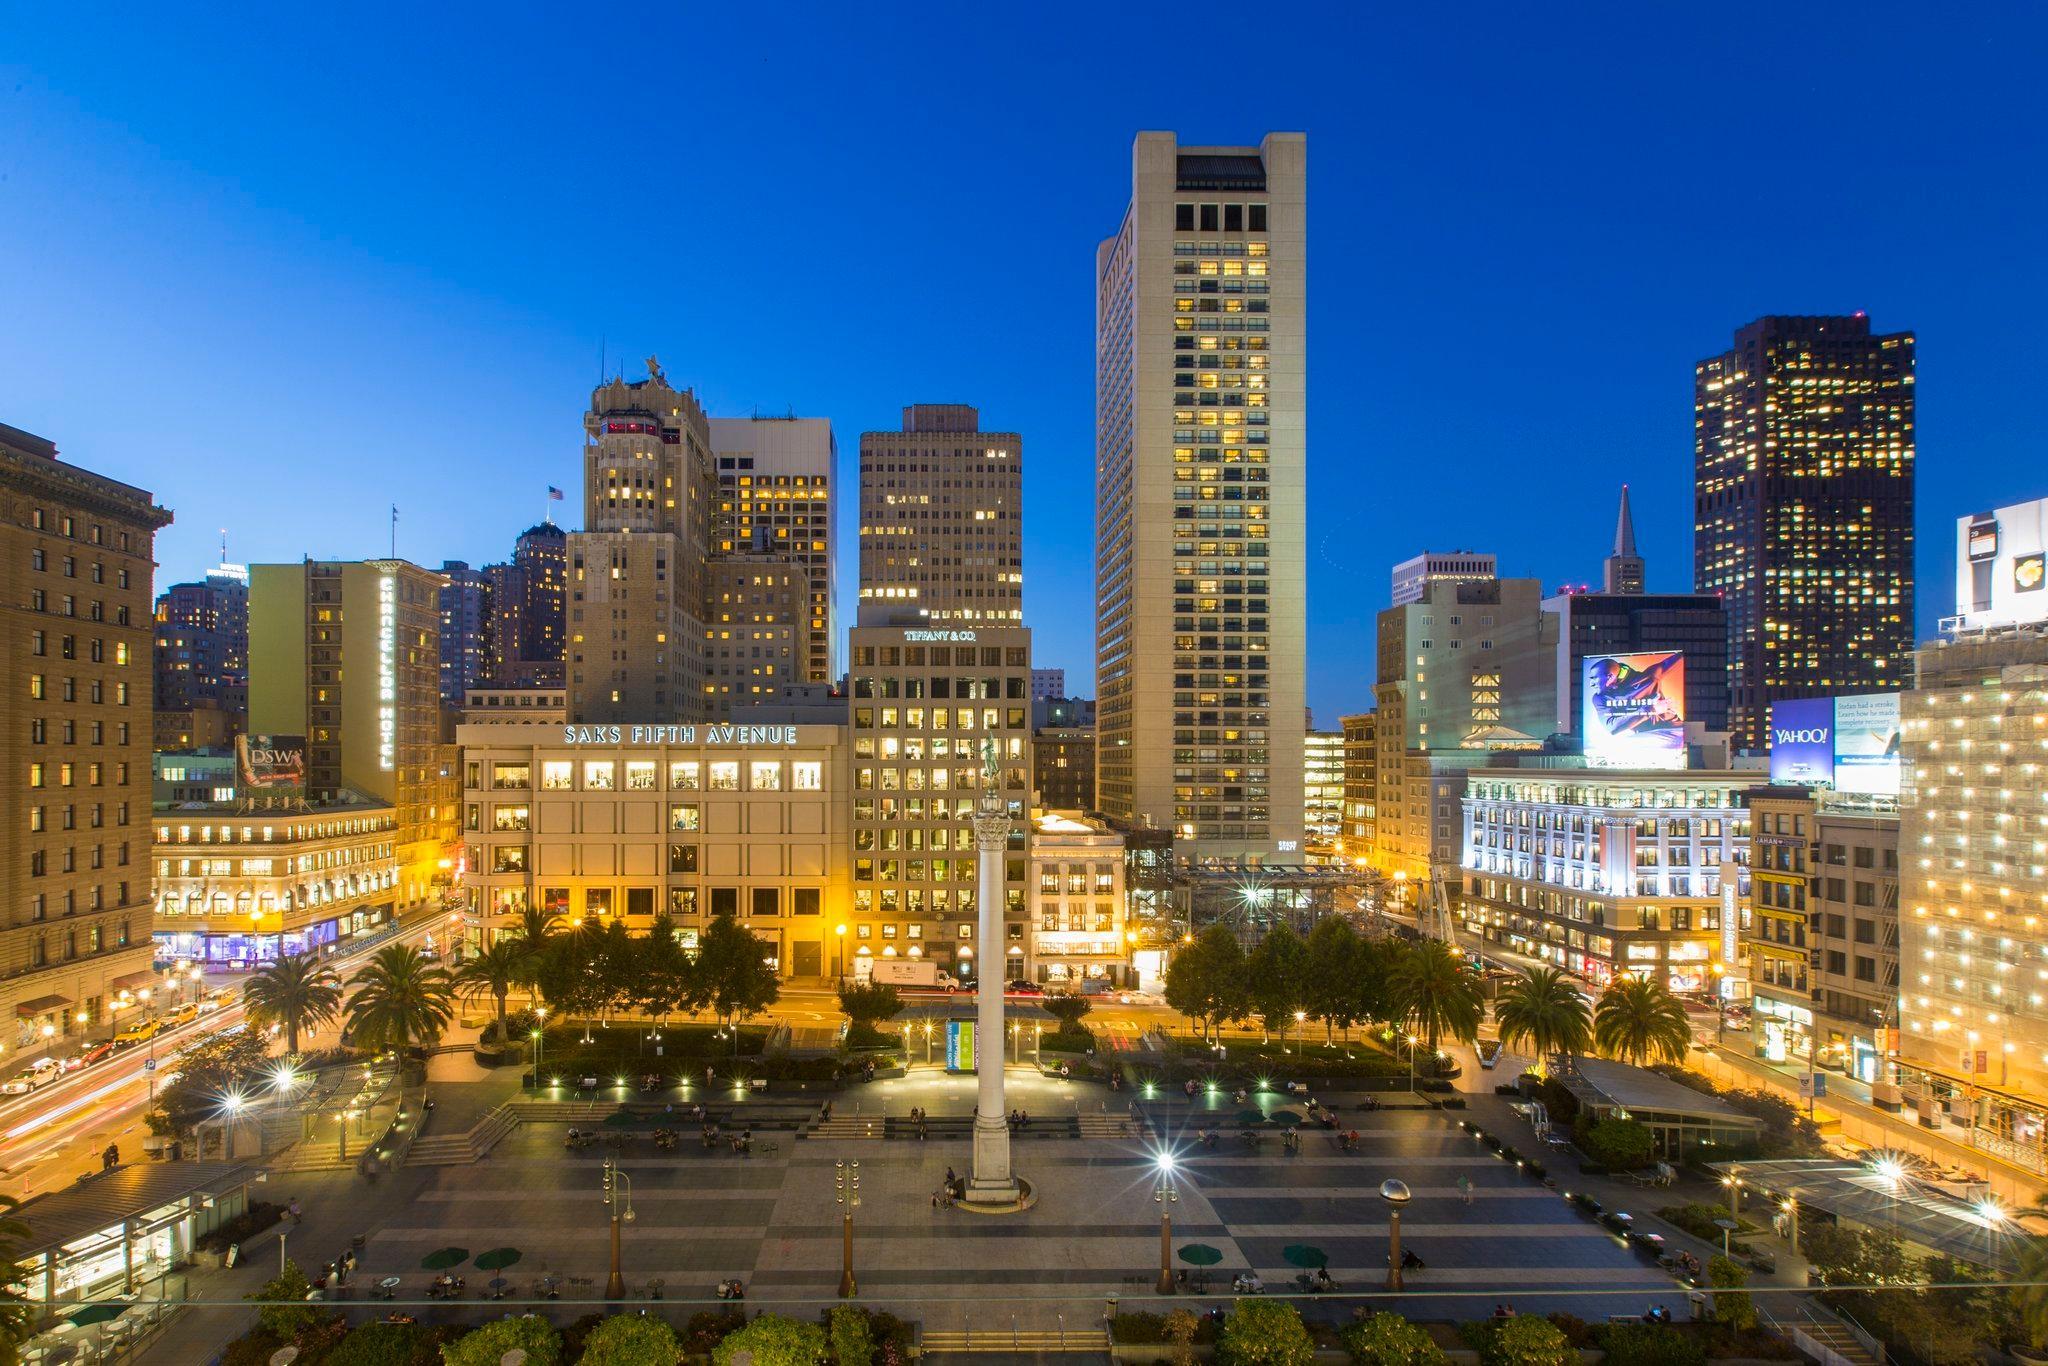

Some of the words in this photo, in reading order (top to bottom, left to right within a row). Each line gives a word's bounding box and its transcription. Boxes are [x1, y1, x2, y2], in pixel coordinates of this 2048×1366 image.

[379, 576, 393, 700] CHANCELLOR
[904, 630, 950, 641] TIFFANY
[950, 631, 959, 641] &
[1857, 701, 1869, 709] had
[380, 707, 393, 769] HOTEL
[565, 726, 621, 743] SAKS
[631, 726, 695, 743] FIFTH
[707, 726, 797, 743] AVENUE
[1775, 728, 1828, 744] YAHOO!
[251, 749, 293, 764] DSW
[1755, 837, 1778, 845] JAHAN
